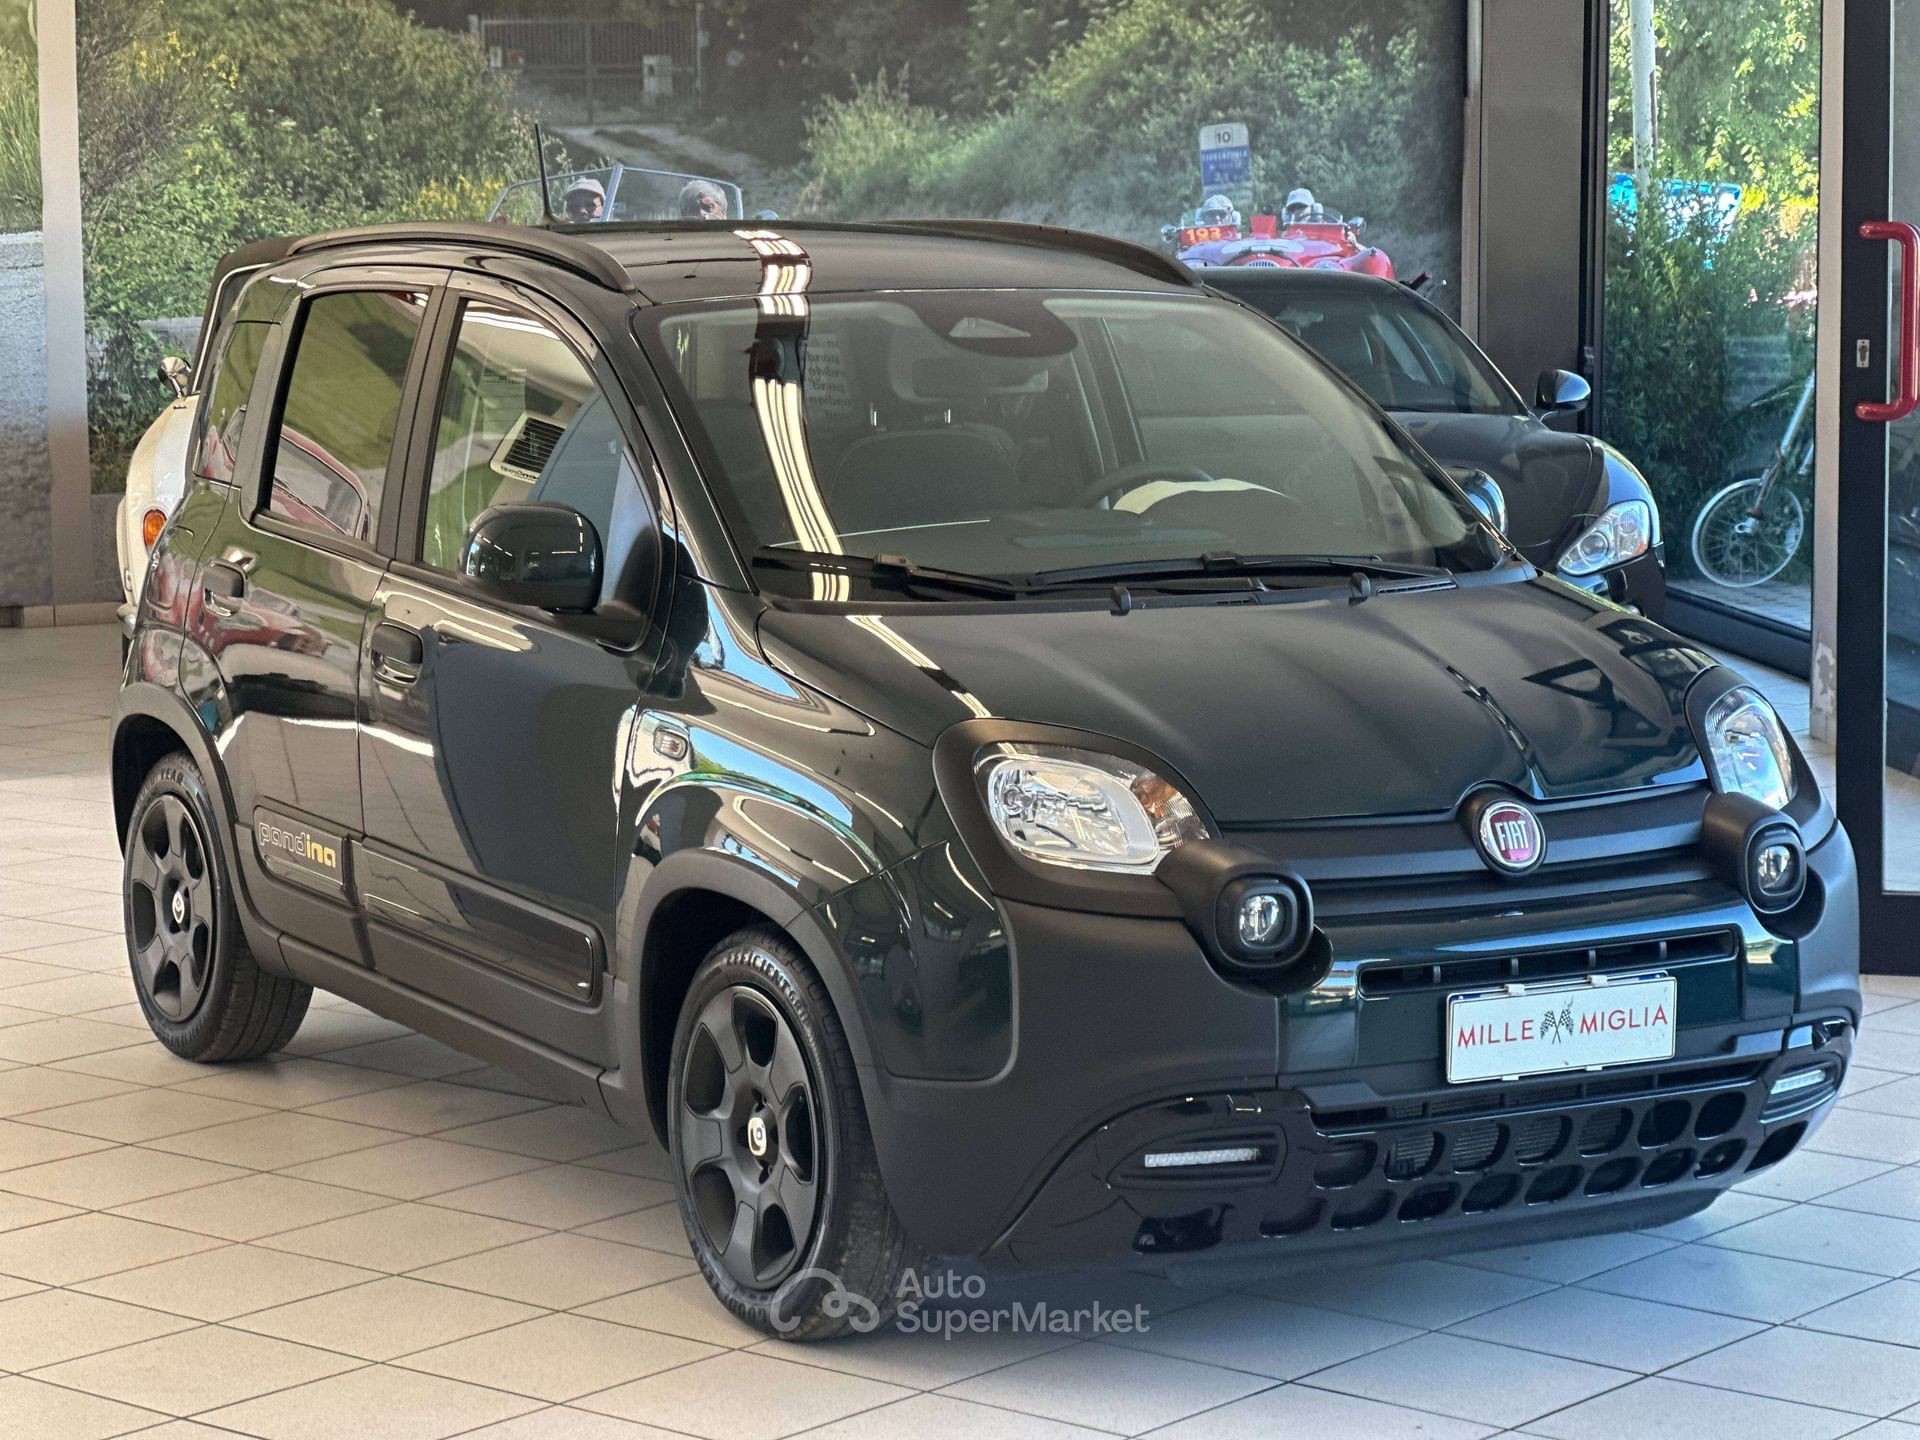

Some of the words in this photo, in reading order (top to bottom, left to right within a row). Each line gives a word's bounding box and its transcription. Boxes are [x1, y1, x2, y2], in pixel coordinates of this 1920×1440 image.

[1216, 131, 1231, 144] 10
[258, 822, 337, 869] pandina
[1494, 820, 1529, 851] FIAT
[1457, 1019, 1535, 1048] MILLE
[1579, 1004, 1669, 1035] MIGLIA
